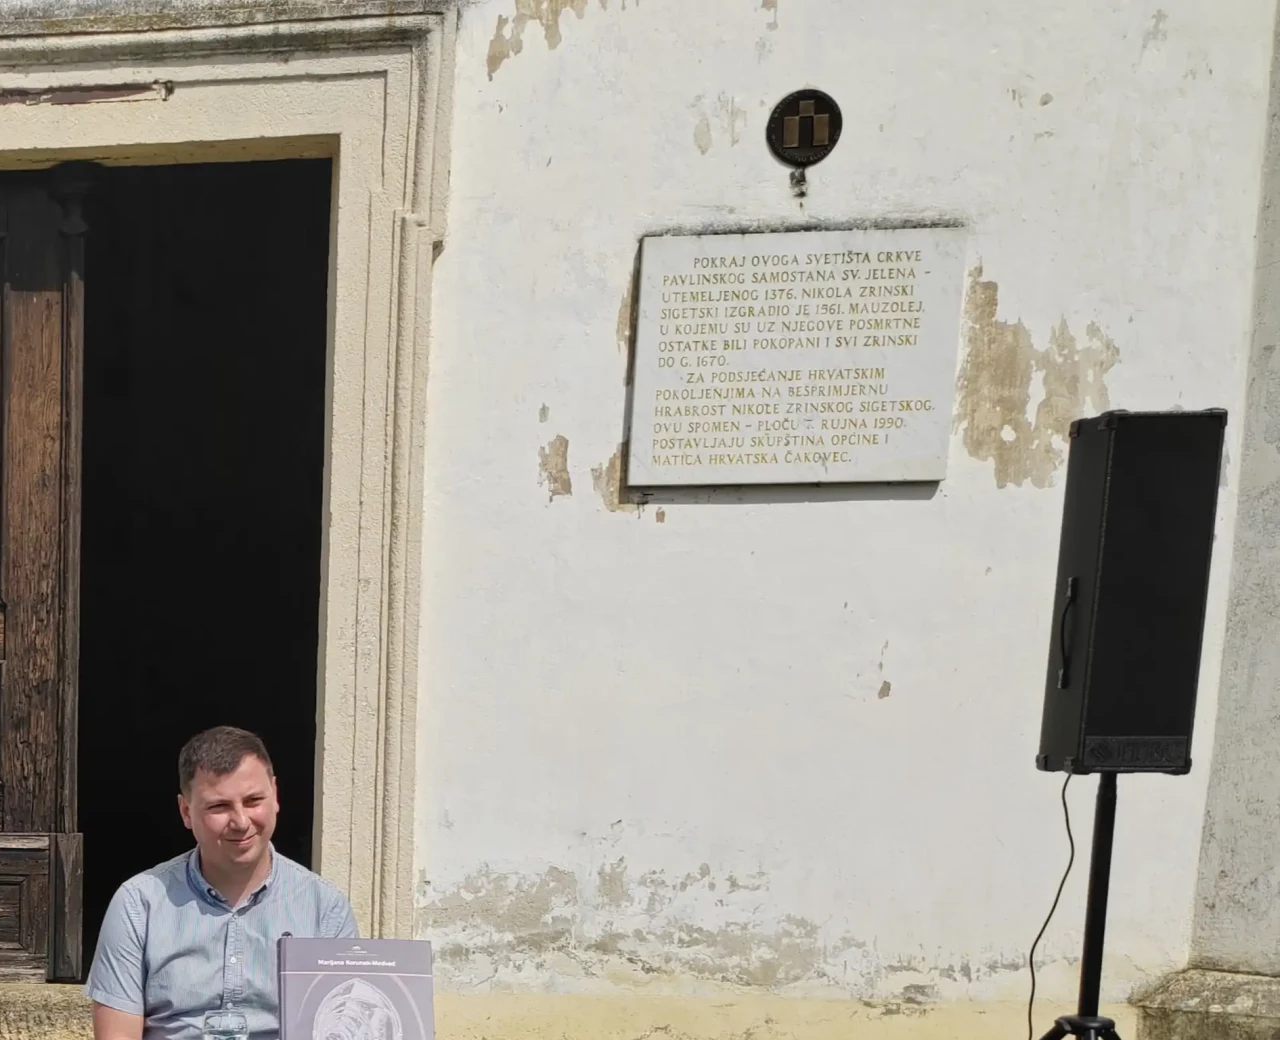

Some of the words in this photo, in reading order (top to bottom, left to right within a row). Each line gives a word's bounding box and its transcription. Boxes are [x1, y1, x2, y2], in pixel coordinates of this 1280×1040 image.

[694, 256, 746, 268] POKRAJ
[751, 255, 800, 267] OVOGA
[806, 250, 871, 265] SVETIŠTA
[877, 250, 922, 263] CRKVE
[663, 273, 745, 286] PAVLINSKOG
[751, 270, 836, 284] SAMOSTANA
[842, 270, 860, 281] SV.
[865, 268, 916, 280] JELENA
[662, 290, 759, 303] UTEMELJENOG
[765, 289, 797, 300] 1376.
[802, 287, 852, 298] NIKOLA
[859, 284, 914, 297] ZRINSKI
[660, 308, 718, 320] SIGETSKI
[724, 305, 790, 318] IZGRADIO
[795, 304, 810, 316] JE
[660, 324, 669, 336] U
[674, 323, 728, 335] KOJEMU
[734, 322, 750, 334] SU
[757, 322, 776, 333] UZ
[782, 320, 843, 332] NJEGOVE
[850, 318, 920, 330] POSMRTNE
[658, 340, 717, 352] OSTATKE
[723, 339, 747, 350] BILI
[752, 337, 820, 350] POKOPANI
[835, 336, 858, 348] SVI
[863, 334, 918, 347] ZRINSKI
[658, 357, 675, 368] DO
[680, 356, 692, 368] G.
[696, 355, 729, 368] 1670.
[686, 373, 705, 384] ZA
[711, 368, 802, 384] PODSJEĆANJE
[808, 368, 885, 381] HRVATSKIM
[656, 388, 756, 401] POKOLJENJIMA
[761, 387, 781, 398] NA
[788, 384, 888, 398] BESPRIMJERNU
[654, 404, 726, 417] HRABROST
[732, 404, 780, 416] NIKOLE
[786, 402, 853, 414] ZRINSKOG
[859, 400, 935, 412] SIGETSKOG.
[653, 422, 682, 434] OVU
[688, 420, 740, 433] SPOMEN
[758, 418, 800, 430] PLOČU
[821, 418, 868, 430] RUJNA
[652, 437, 745, 450] POSTAVLJAJU
[750, 434, 824, 448] SKUPŠTINA
[831, 432, 880, 446] OPĆINE
[652, 454, 702, 466] MATICA
[708, 452, 778, 465] HRVATSKA
[784, 450, 852, 464] ČAKOVEC.
